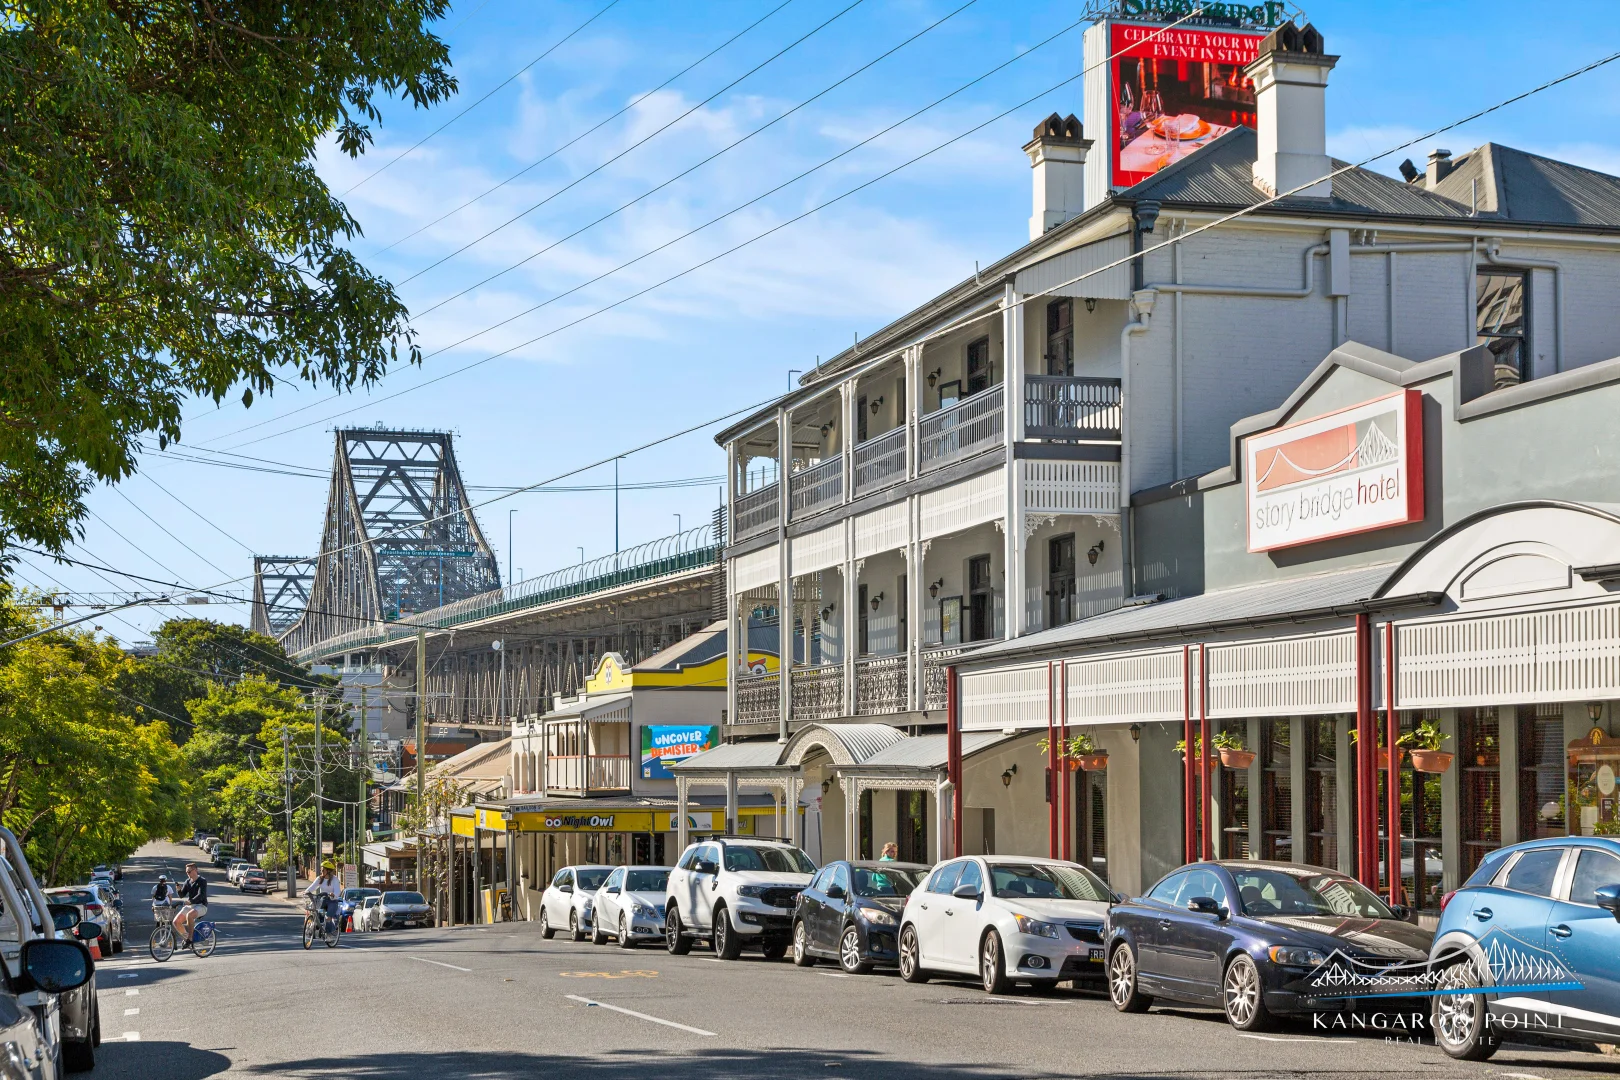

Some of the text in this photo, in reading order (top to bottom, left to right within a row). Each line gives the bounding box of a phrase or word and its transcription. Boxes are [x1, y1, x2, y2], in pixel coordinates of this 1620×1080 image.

[1124, 0, 1285, 27] STORY BRIDGE
[1124, 28, 1200, 46] CELEBRATE
[1204, 35, 1240, 49] YOUR
[1154, 44, 1259, 63] EVENT IN STYLE
[1256, 468, 1400, 531] story bridge hotel
[655, 730, 702, 745] UNCOVER
[562, 815, 615, 829] NightOwl
